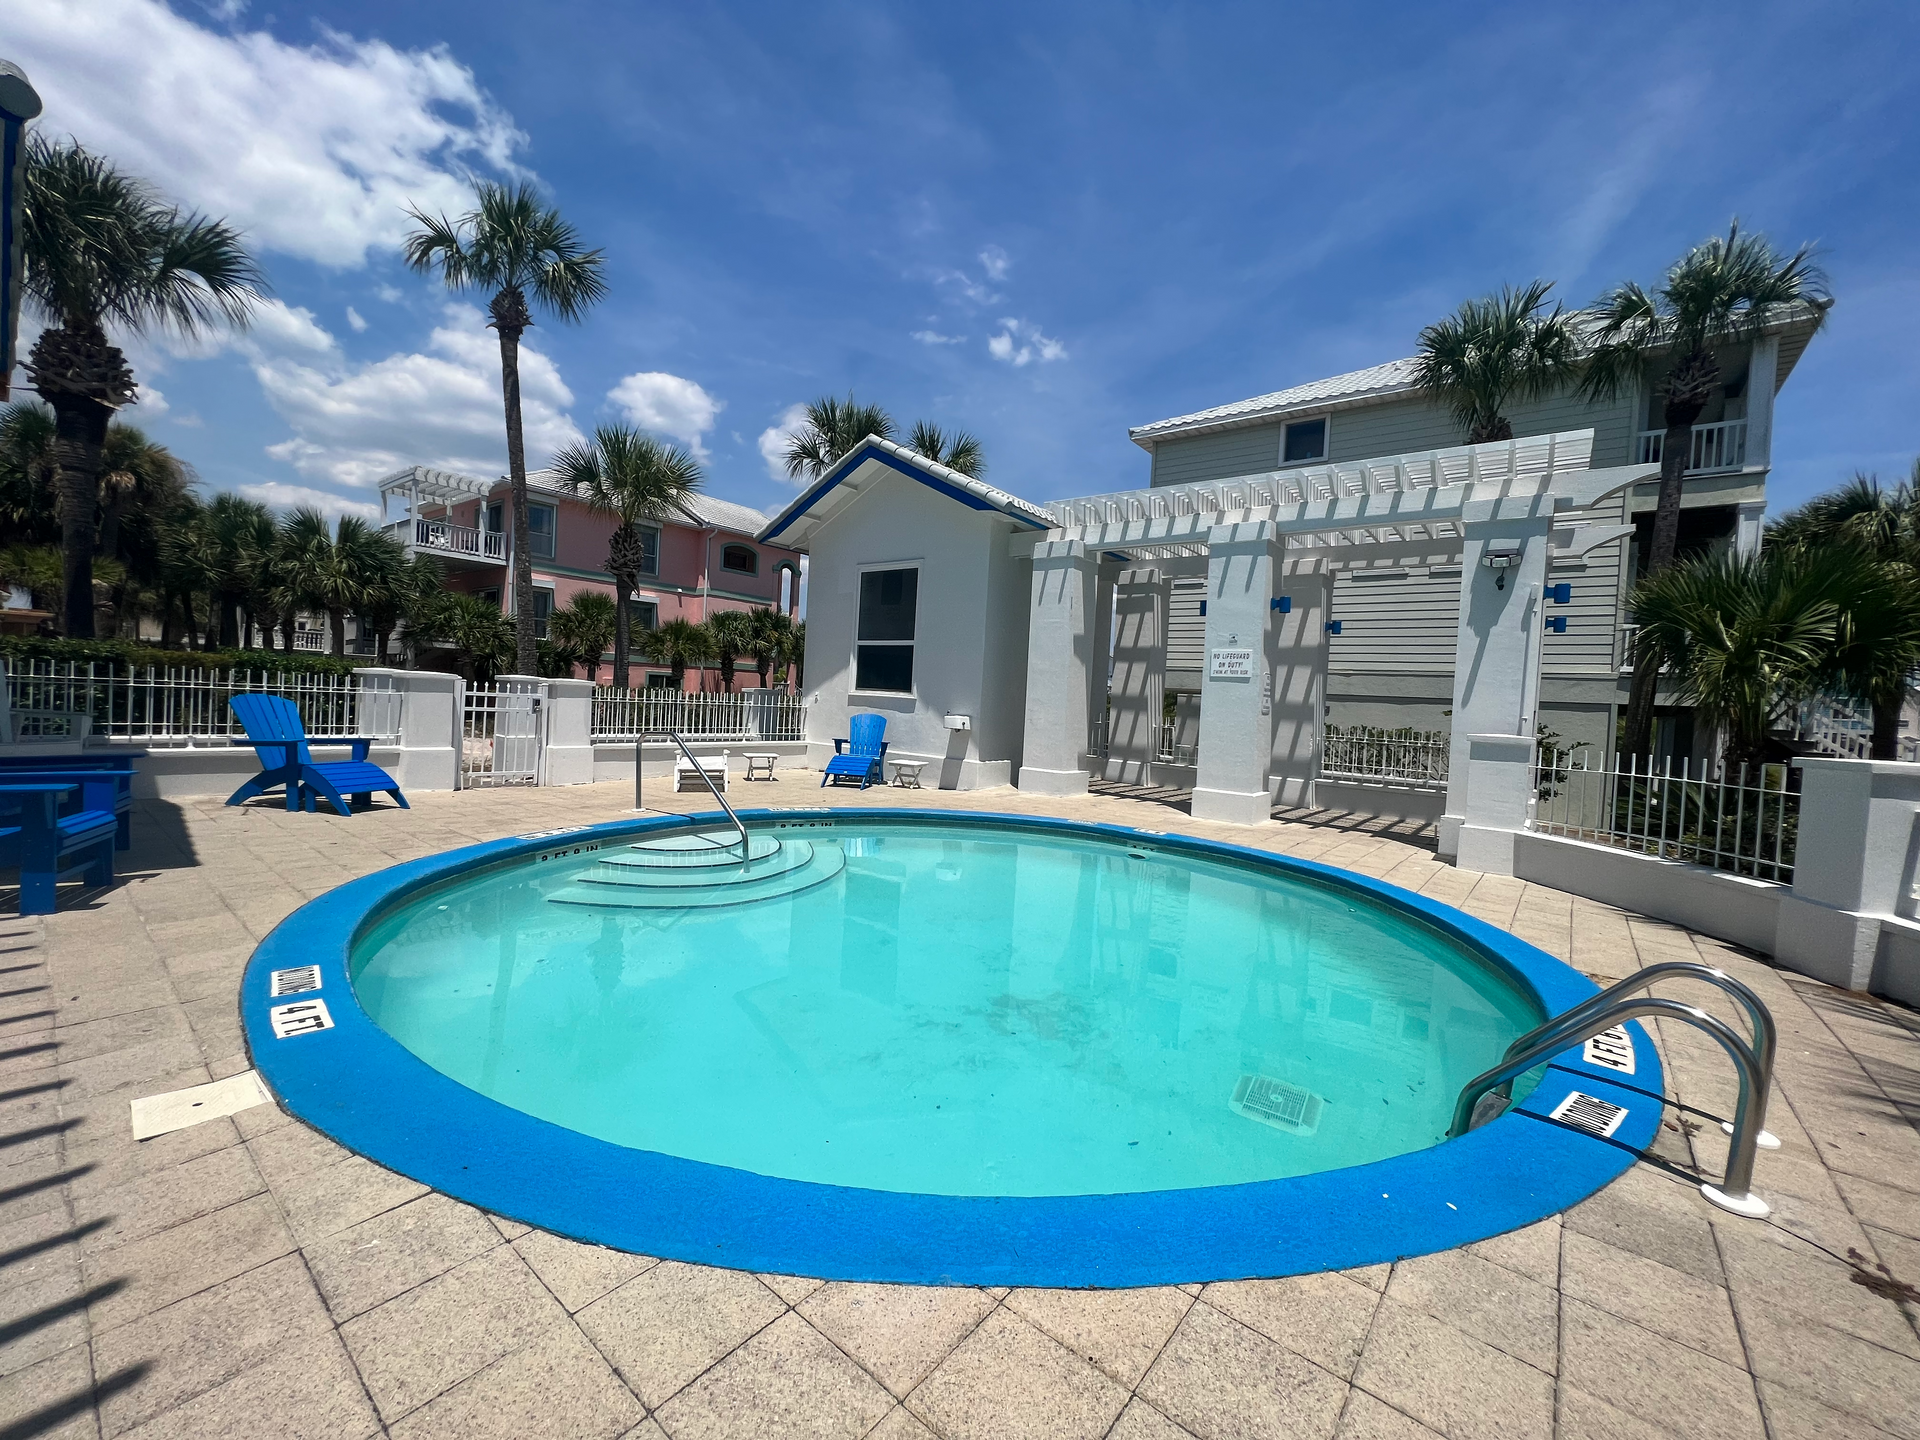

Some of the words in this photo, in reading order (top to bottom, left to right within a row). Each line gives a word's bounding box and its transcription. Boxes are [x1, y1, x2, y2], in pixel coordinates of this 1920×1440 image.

[1222, 652, 1250, 660] LIFEGUARD
[279, 1005, 317, 1015] 4
[1591, 1054, 1628, 1067] 4
[1563, 1094, 1622, 1127] DIVING
